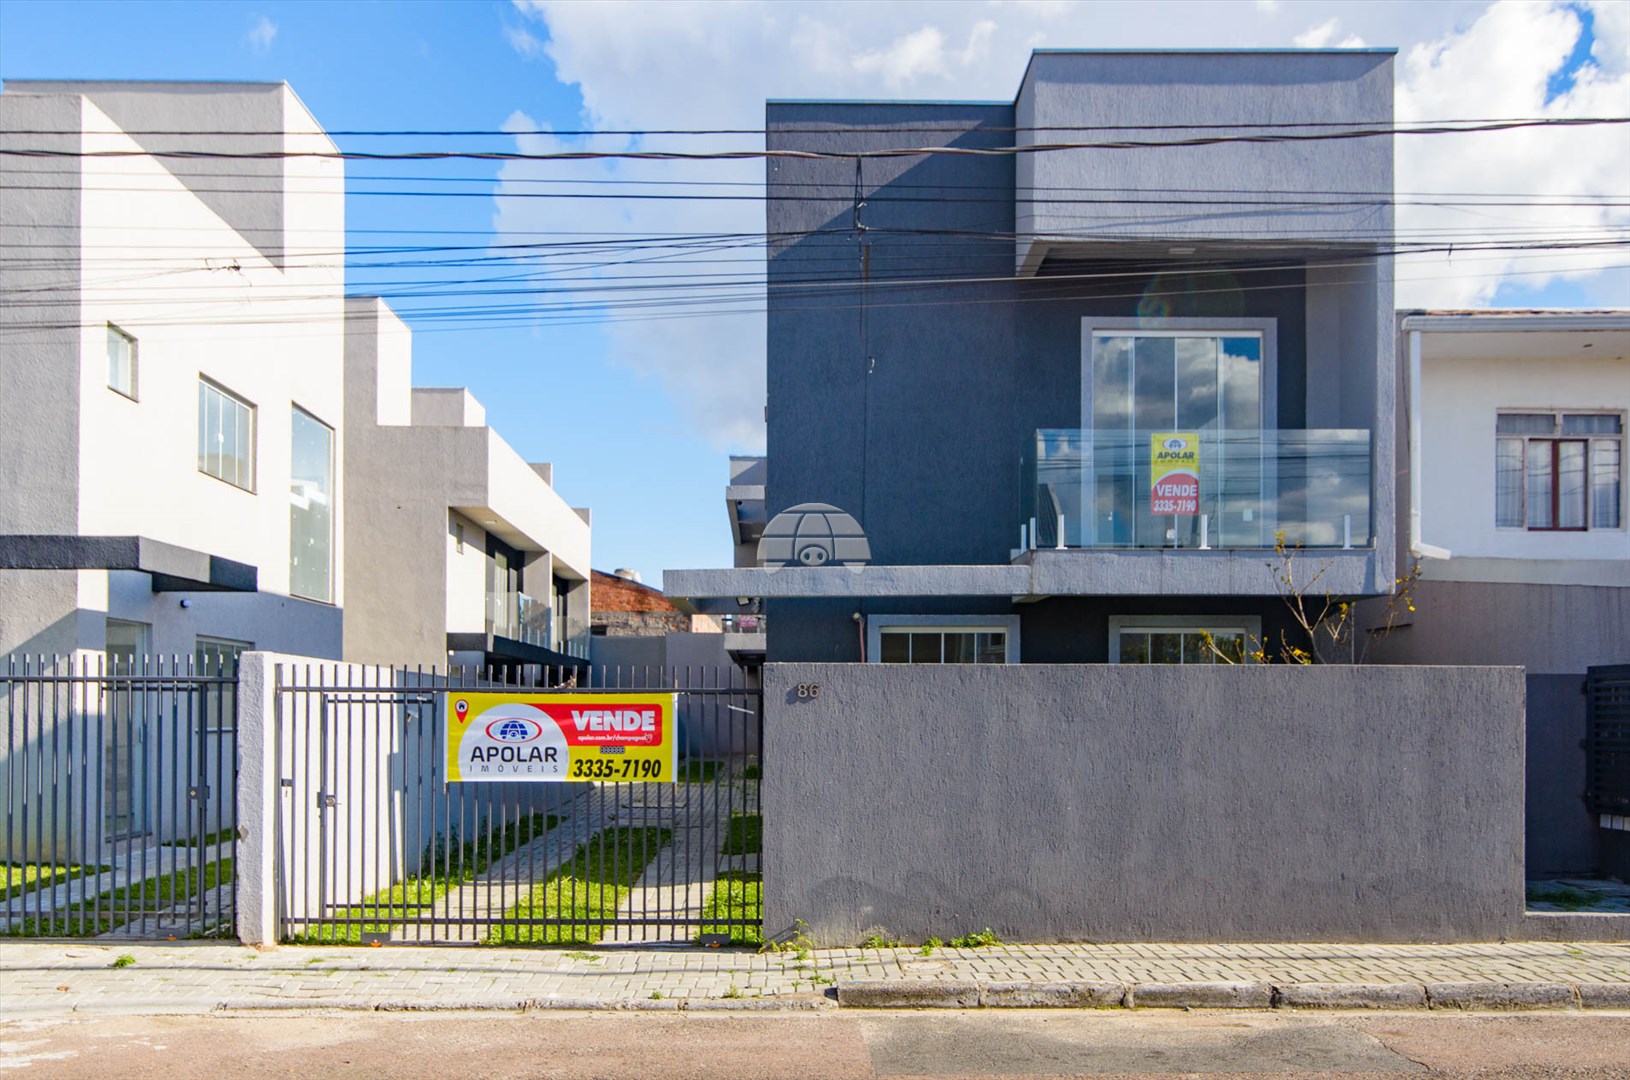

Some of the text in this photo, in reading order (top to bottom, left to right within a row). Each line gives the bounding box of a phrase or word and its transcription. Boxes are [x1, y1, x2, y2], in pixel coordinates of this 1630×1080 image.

[1156, 485, 1198, 497] VENDE
[1154, 500, 1197, 512] 3335-7190
[797, 683, 820, 698] 86
[571, 710, 656, 731] VENDE
[470, 746, 558, 763] APOLAR
[573, 759, 662, 778] 3335-7190
